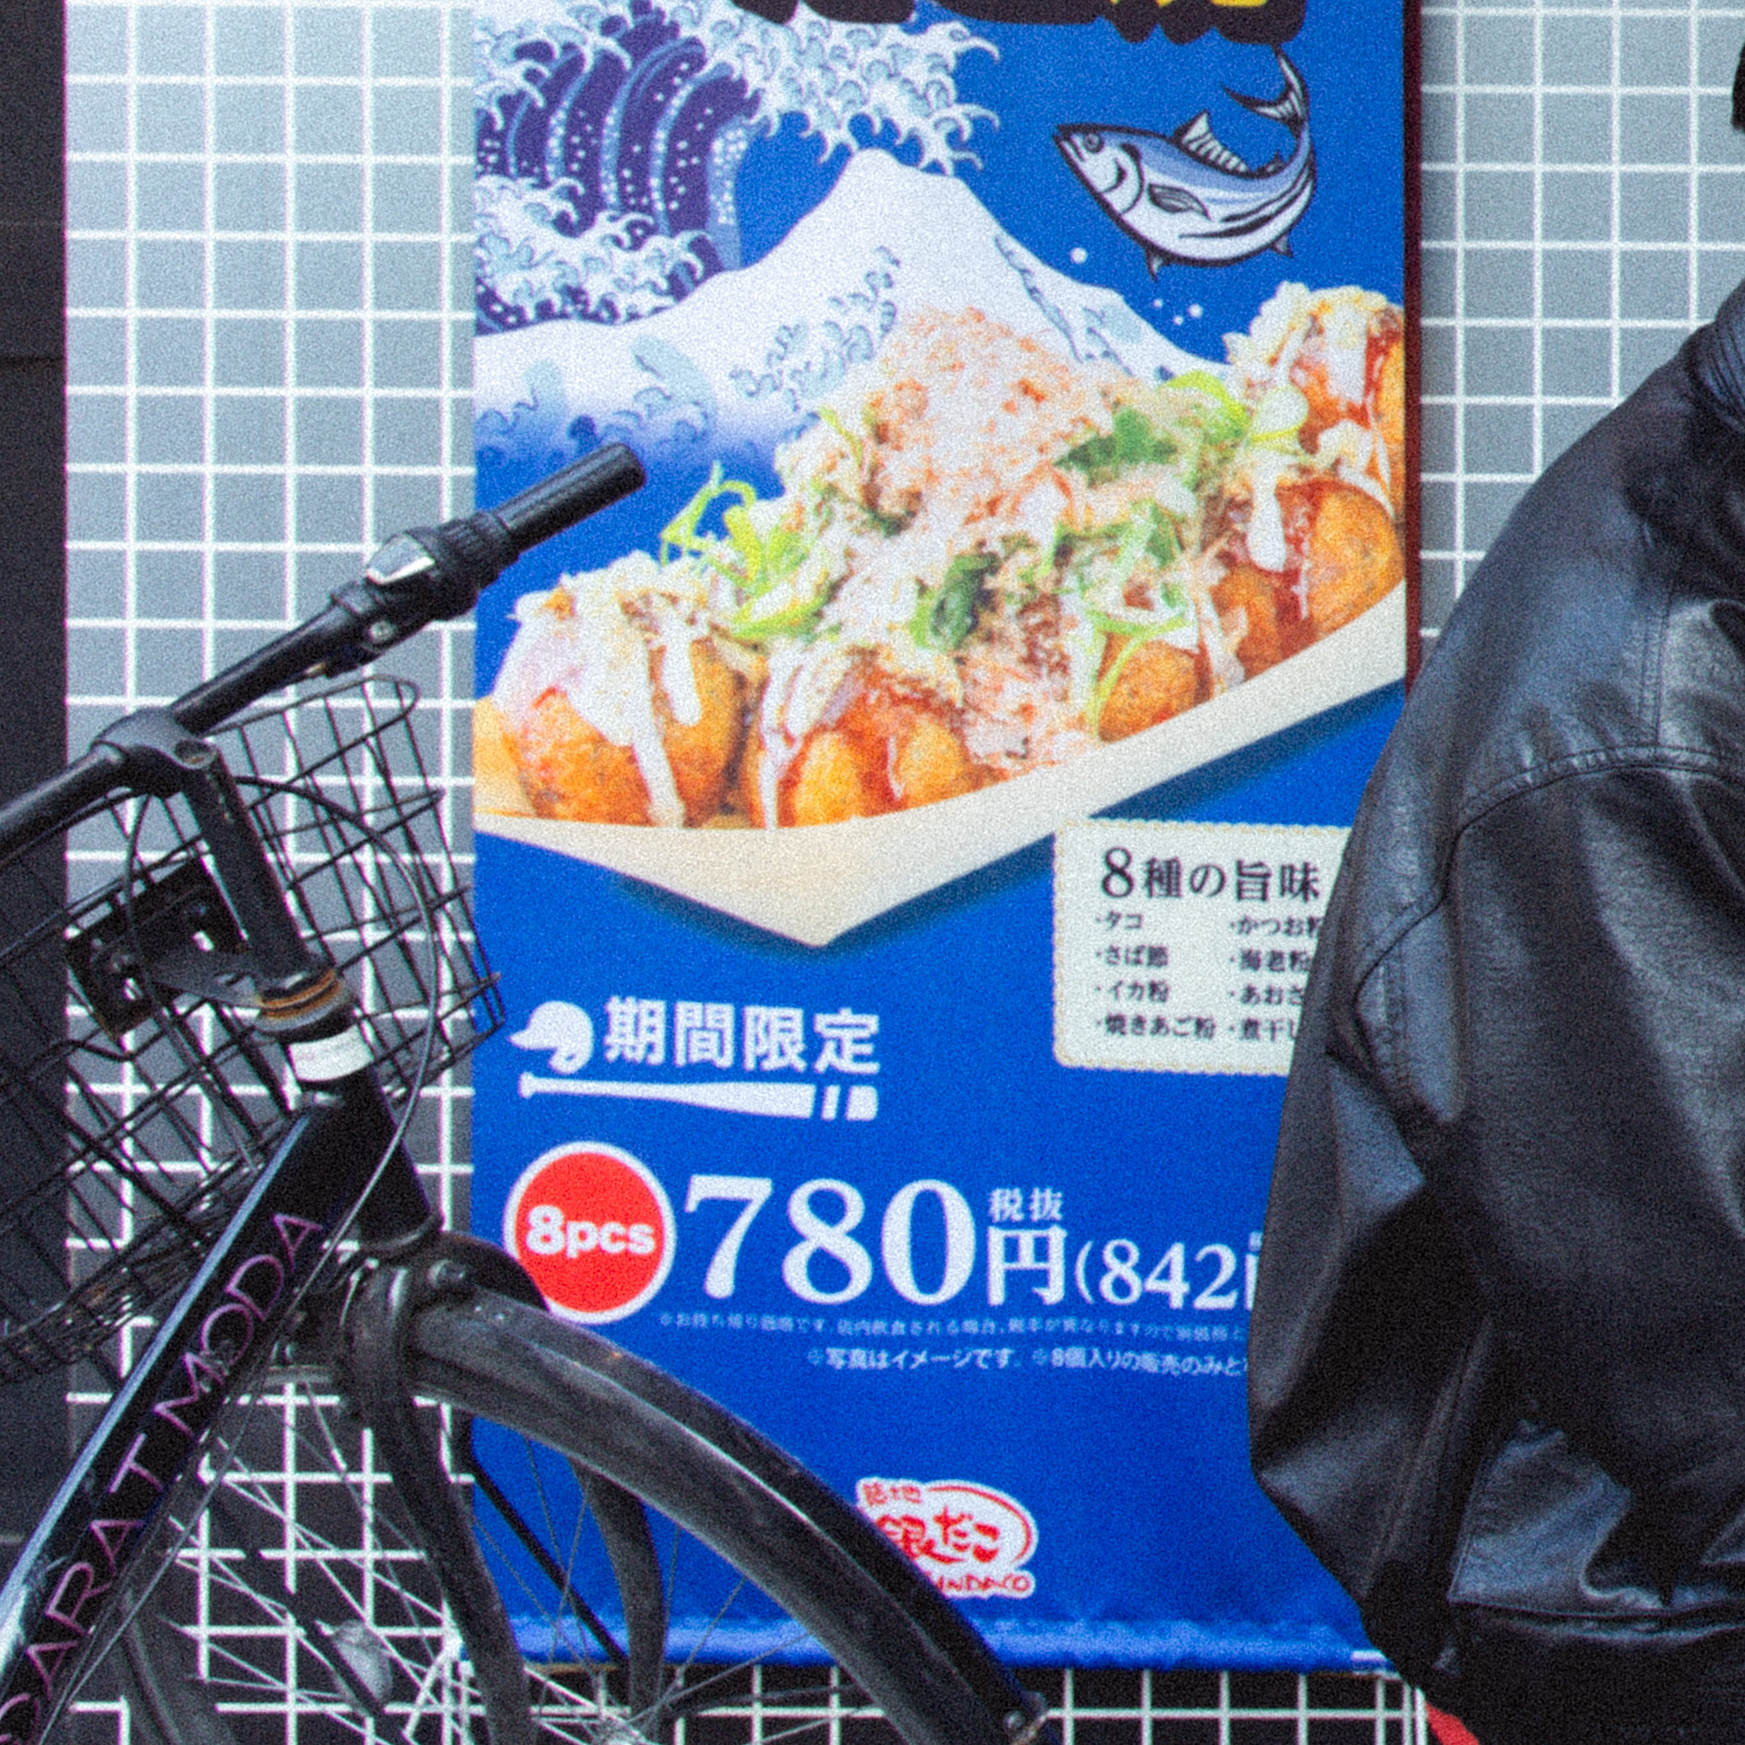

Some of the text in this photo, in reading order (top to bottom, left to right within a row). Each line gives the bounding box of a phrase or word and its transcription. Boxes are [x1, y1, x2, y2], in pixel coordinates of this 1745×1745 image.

[602, 996, 881, 1075] 期間限定
[525, 1204, 656, 1259] 8pcs
[988, 1187, 1064, 1223] 税抜
[682, 1172, 1068, 1309] 780円
[153, 1211, 323, 1440] MODA
[924, 1572, 1031, 1593] INDACO
